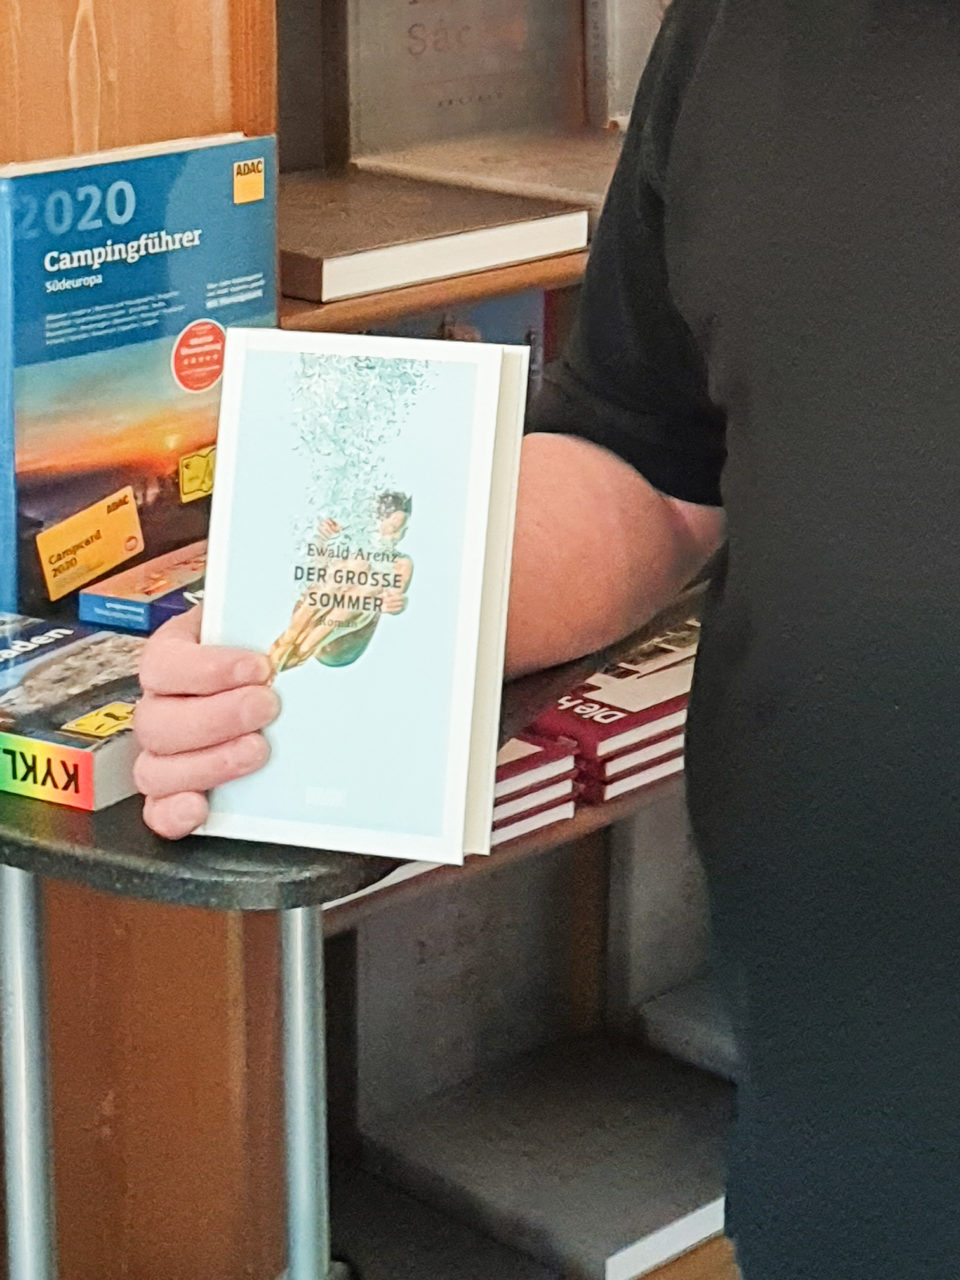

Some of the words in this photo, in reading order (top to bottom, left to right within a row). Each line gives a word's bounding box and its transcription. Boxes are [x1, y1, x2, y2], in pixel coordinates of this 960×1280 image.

[236, 160, 263, 176] ADAC
[14, 180, 136, 240] 2020
[44, 228, 202, 272] Campingführer
[45, 274, 103, 293] Südeuropa
[307, 543, 350, 560] Ewald
[354, 548, 399, 563] Arenz
[294, 566, 327, 583] DER
[333, 569, 402, 588] GROSSE
[308, 591, 383, 613] SOMMER
[0, 628, 75, 663] aden
[0, 748, 80, 794] KYKL
